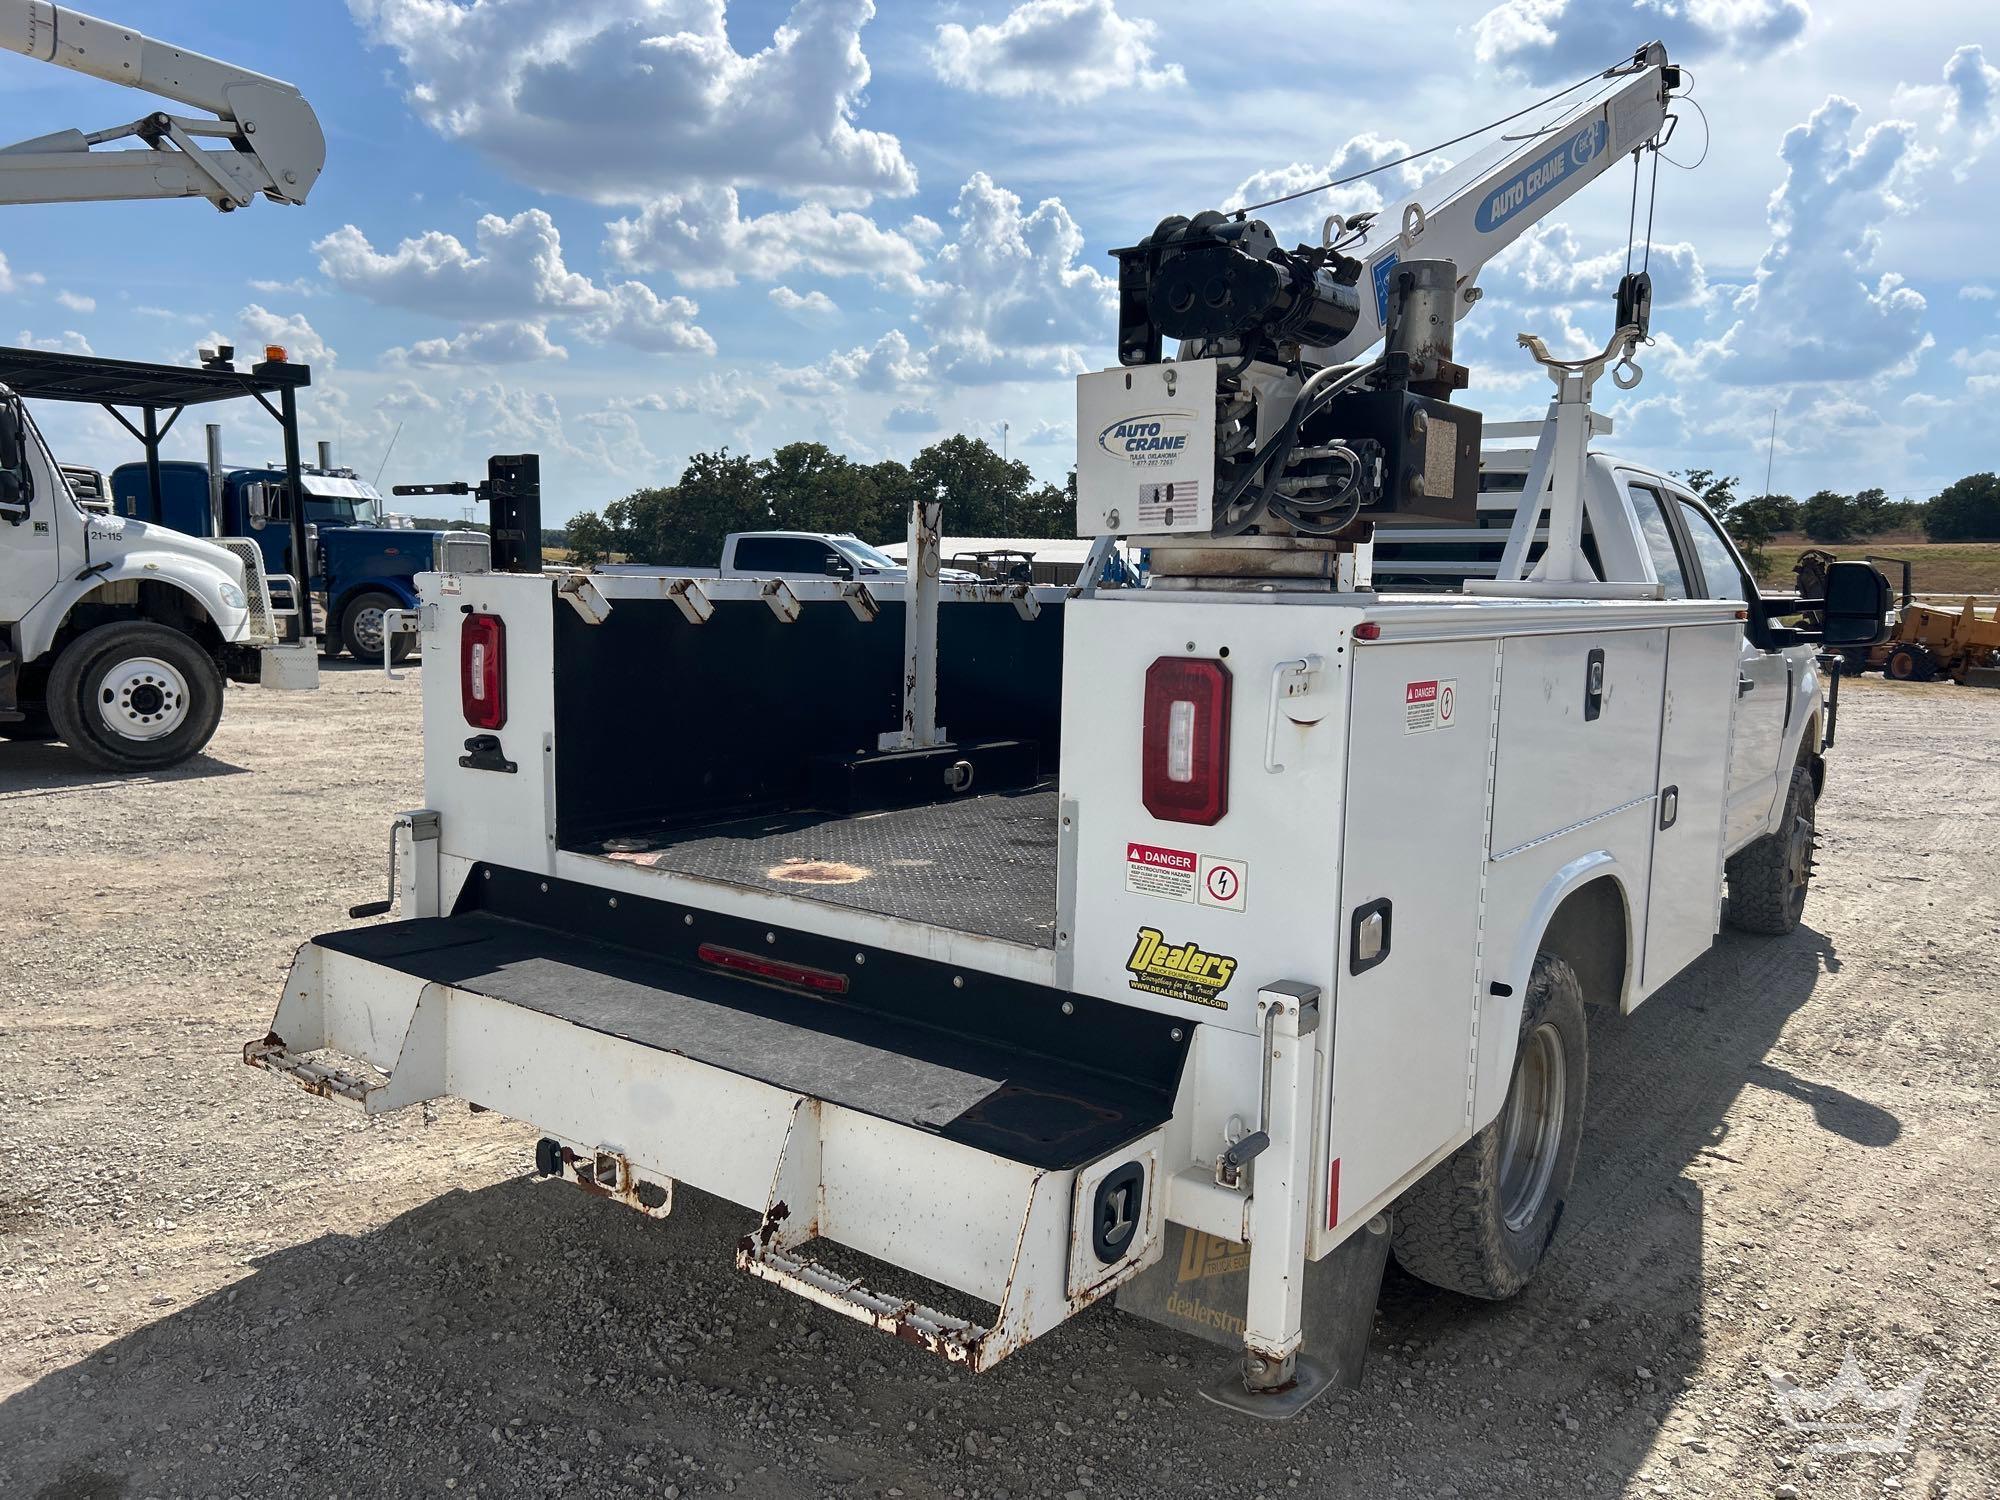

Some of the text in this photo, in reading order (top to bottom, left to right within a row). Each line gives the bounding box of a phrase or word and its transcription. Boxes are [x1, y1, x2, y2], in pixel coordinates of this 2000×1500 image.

[1490, 152, 1565, 223] AUTO CRANE
[1113, 422, 1187, 452] AUTO CRANE
[91, 531, 122, 541] 21-115
[1414, 686, 1436, 699] DANGER
[1145, 851, 1191, 868] DANGER
[1131, 864, 1170, 876] ELECTROCUTION
[1170, 870, 1191, 879] HAZARD
[1128, 928, 1236, 986] Dealers
[1150, 966, 1168, 975] TRUCK
[1168, 971, 1198, 981] EQUIPMENT
[1130, 981, 1228, 1009] WWW.DEALERSTRUCK.COM
[1207, 1258, 1233, 1274] TRUCK
